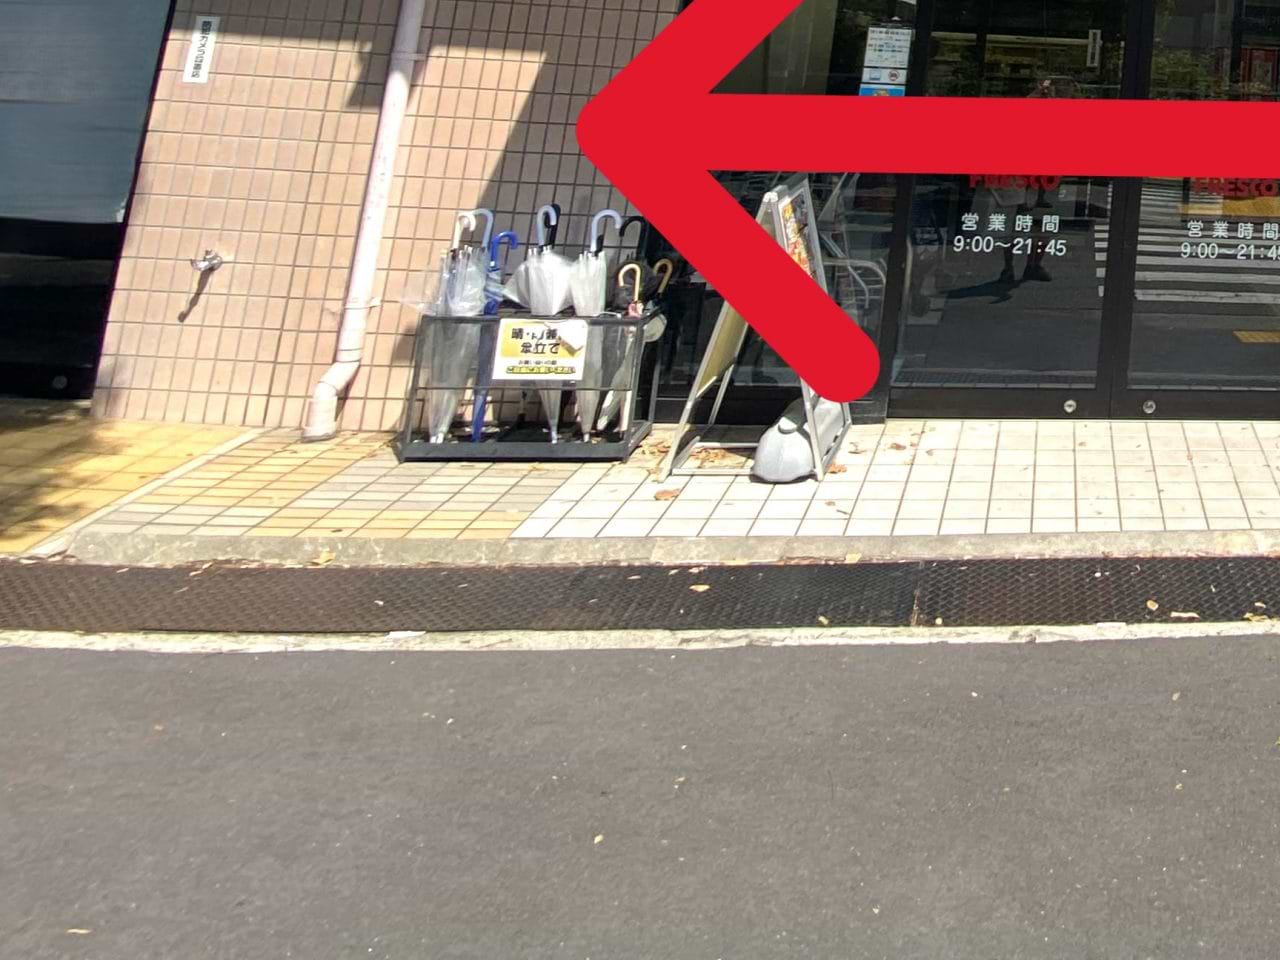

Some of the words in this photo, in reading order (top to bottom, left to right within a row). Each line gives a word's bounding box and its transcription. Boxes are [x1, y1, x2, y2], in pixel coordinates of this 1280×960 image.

[961, 212, 1060, 233] 営業時間
[1187, 220, 1280, 241] 営業時間
